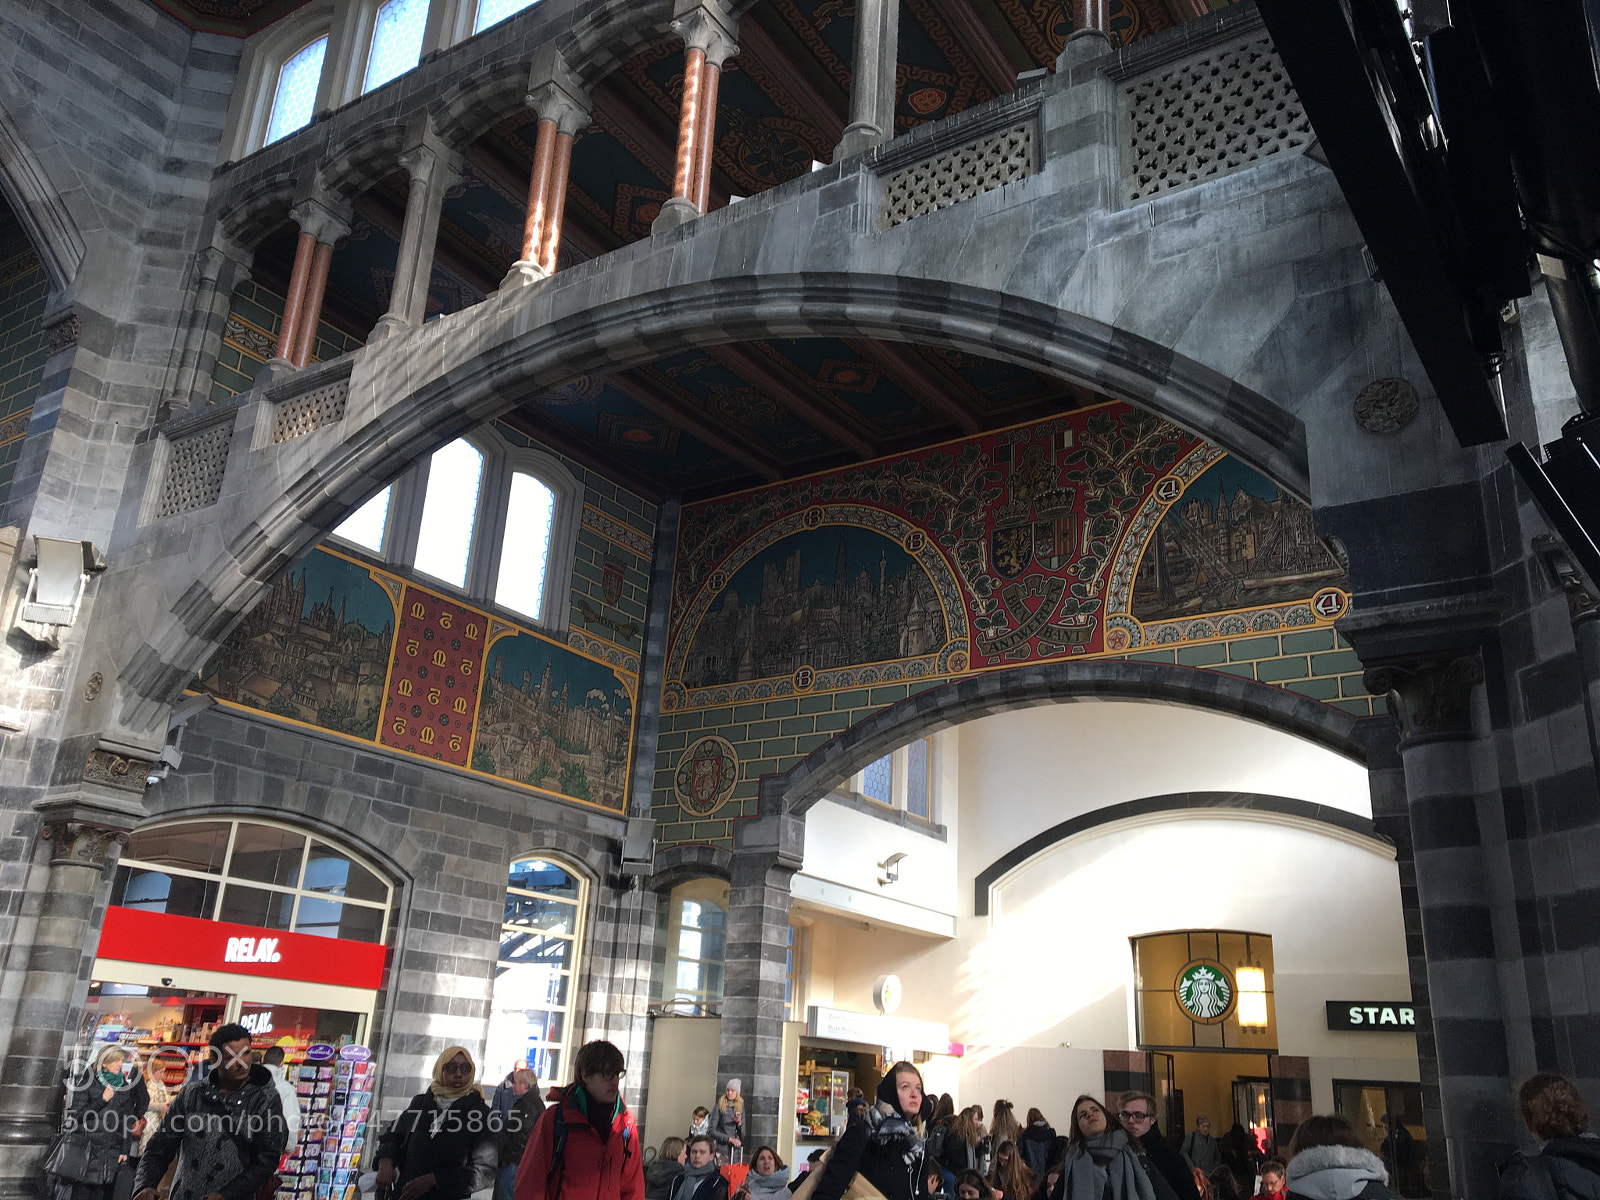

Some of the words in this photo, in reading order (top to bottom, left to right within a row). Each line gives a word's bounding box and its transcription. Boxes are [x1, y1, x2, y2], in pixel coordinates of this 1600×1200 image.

[807, 509, 820, 525] B
[909, 532, 923, 549] B
[711, 574, 724, 589] B
[797, 669, 811, 687] B
[1349, 1006, 1415, 1025] STAR
